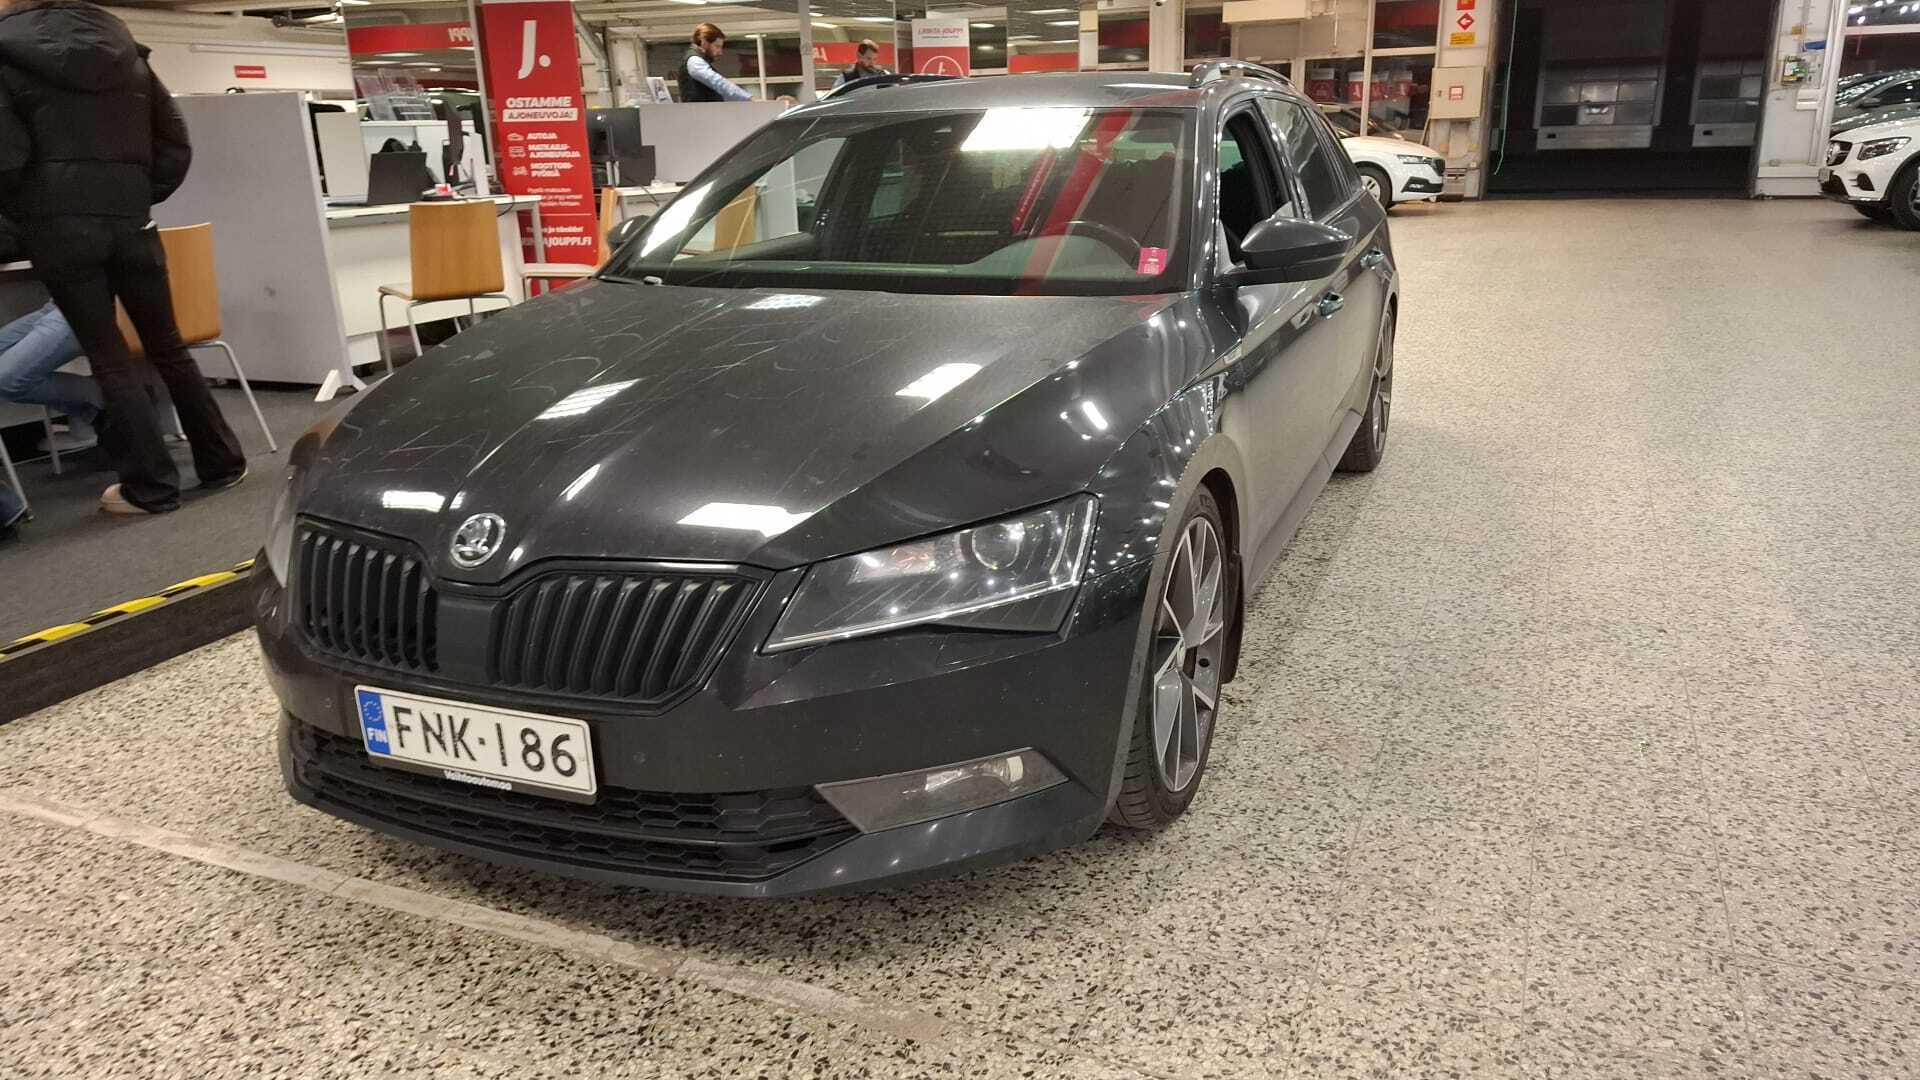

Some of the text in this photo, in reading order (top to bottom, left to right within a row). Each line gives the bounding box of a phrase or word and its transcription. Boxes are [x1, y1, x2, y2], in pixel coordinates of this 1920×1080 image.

[506, 96, 572, 108] OSTAMME
[507, 110, 574, 120] AJONEUVOJA!
[526, 132, 558, 140] AUTOJA
[367, 727, 388, 743] FIN
